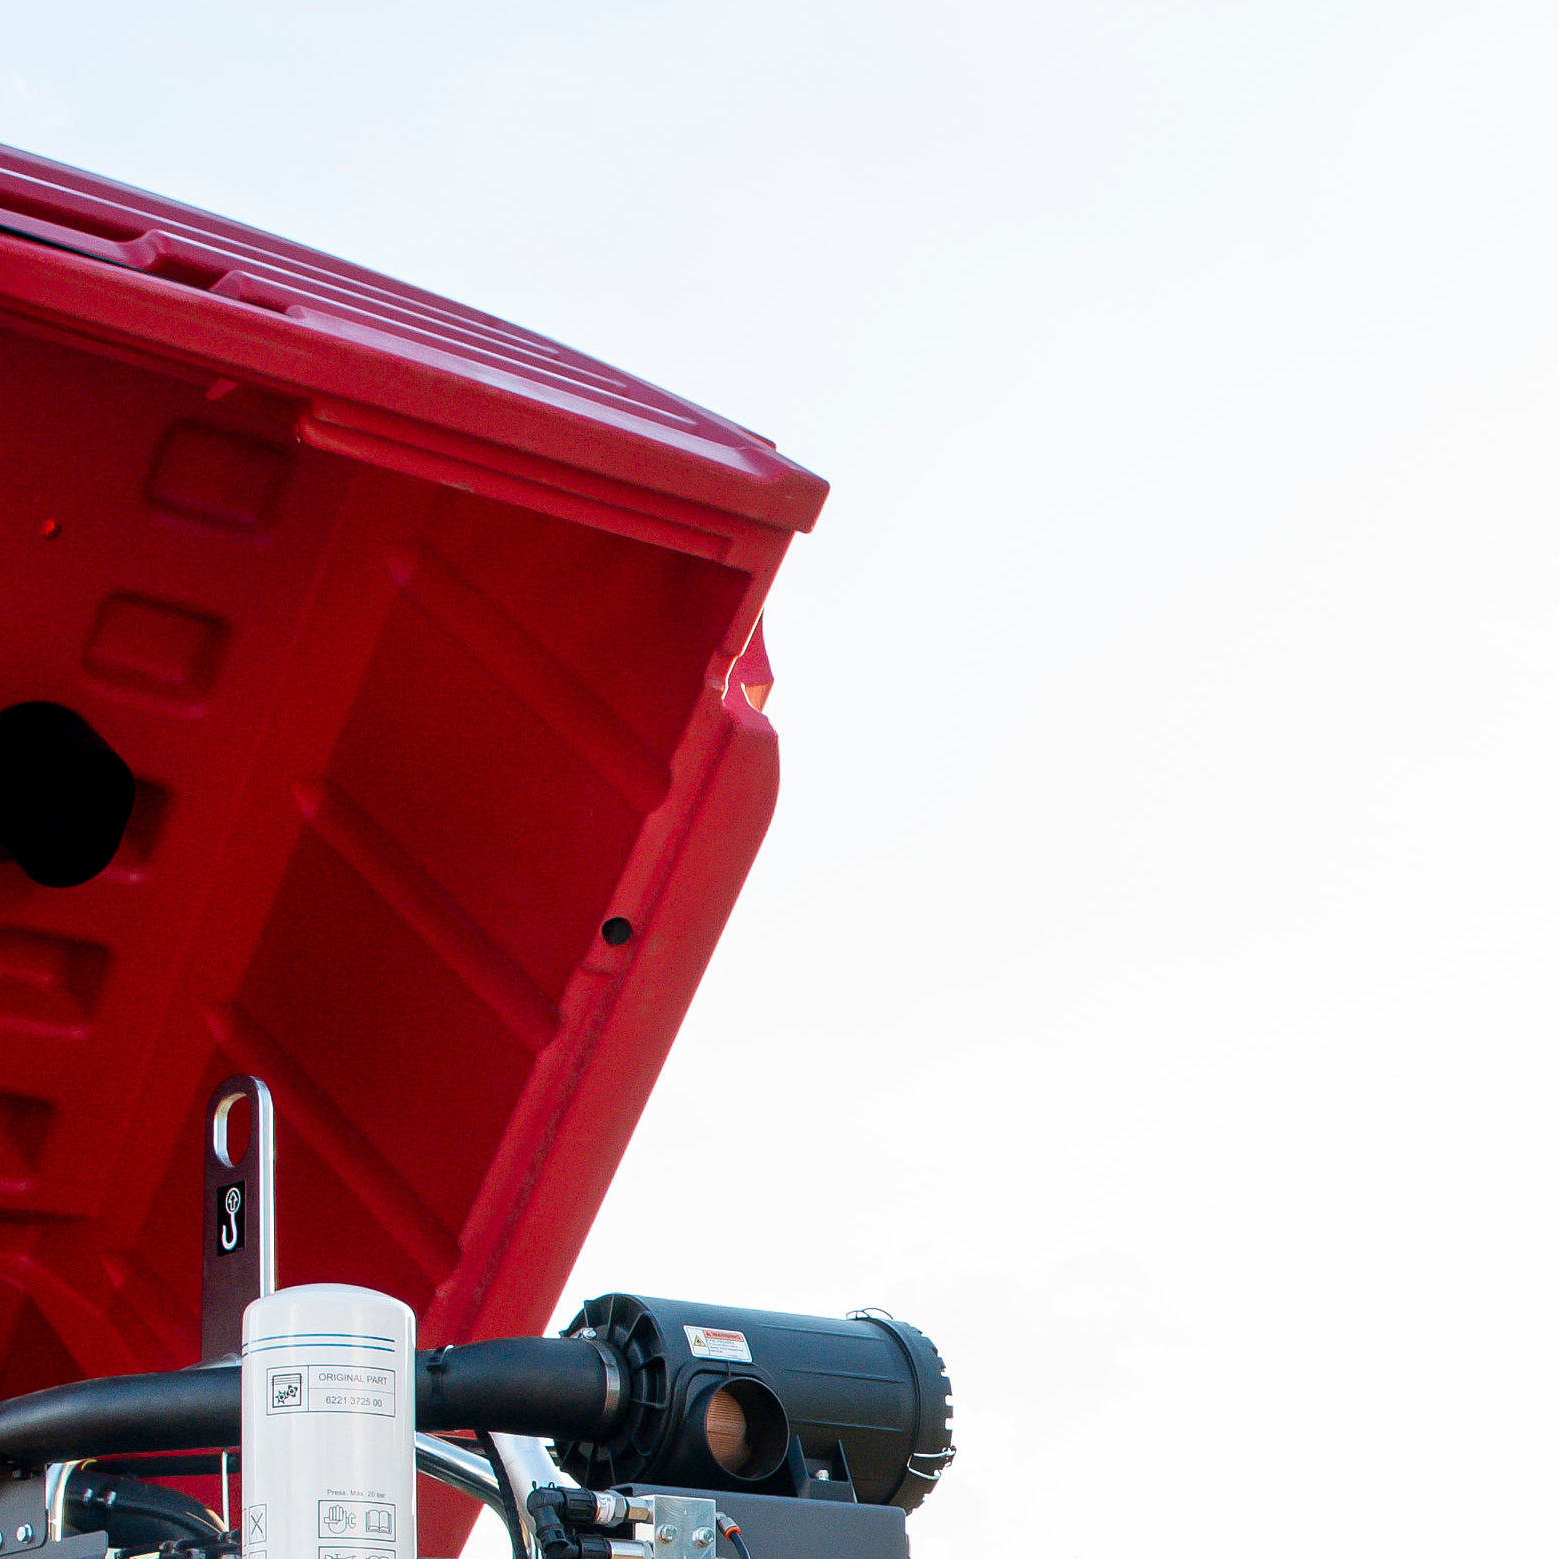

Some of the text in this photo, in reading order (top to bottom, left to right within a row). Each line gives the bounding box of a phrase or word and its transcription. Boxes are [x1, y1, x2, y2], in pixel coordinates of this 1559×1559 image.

[318, 1373, 388, 1385] ORIGINAL PART
[325, 1395, 383, 1407] 6221 3725 00
[367, 1490, 376, 1498] 20
